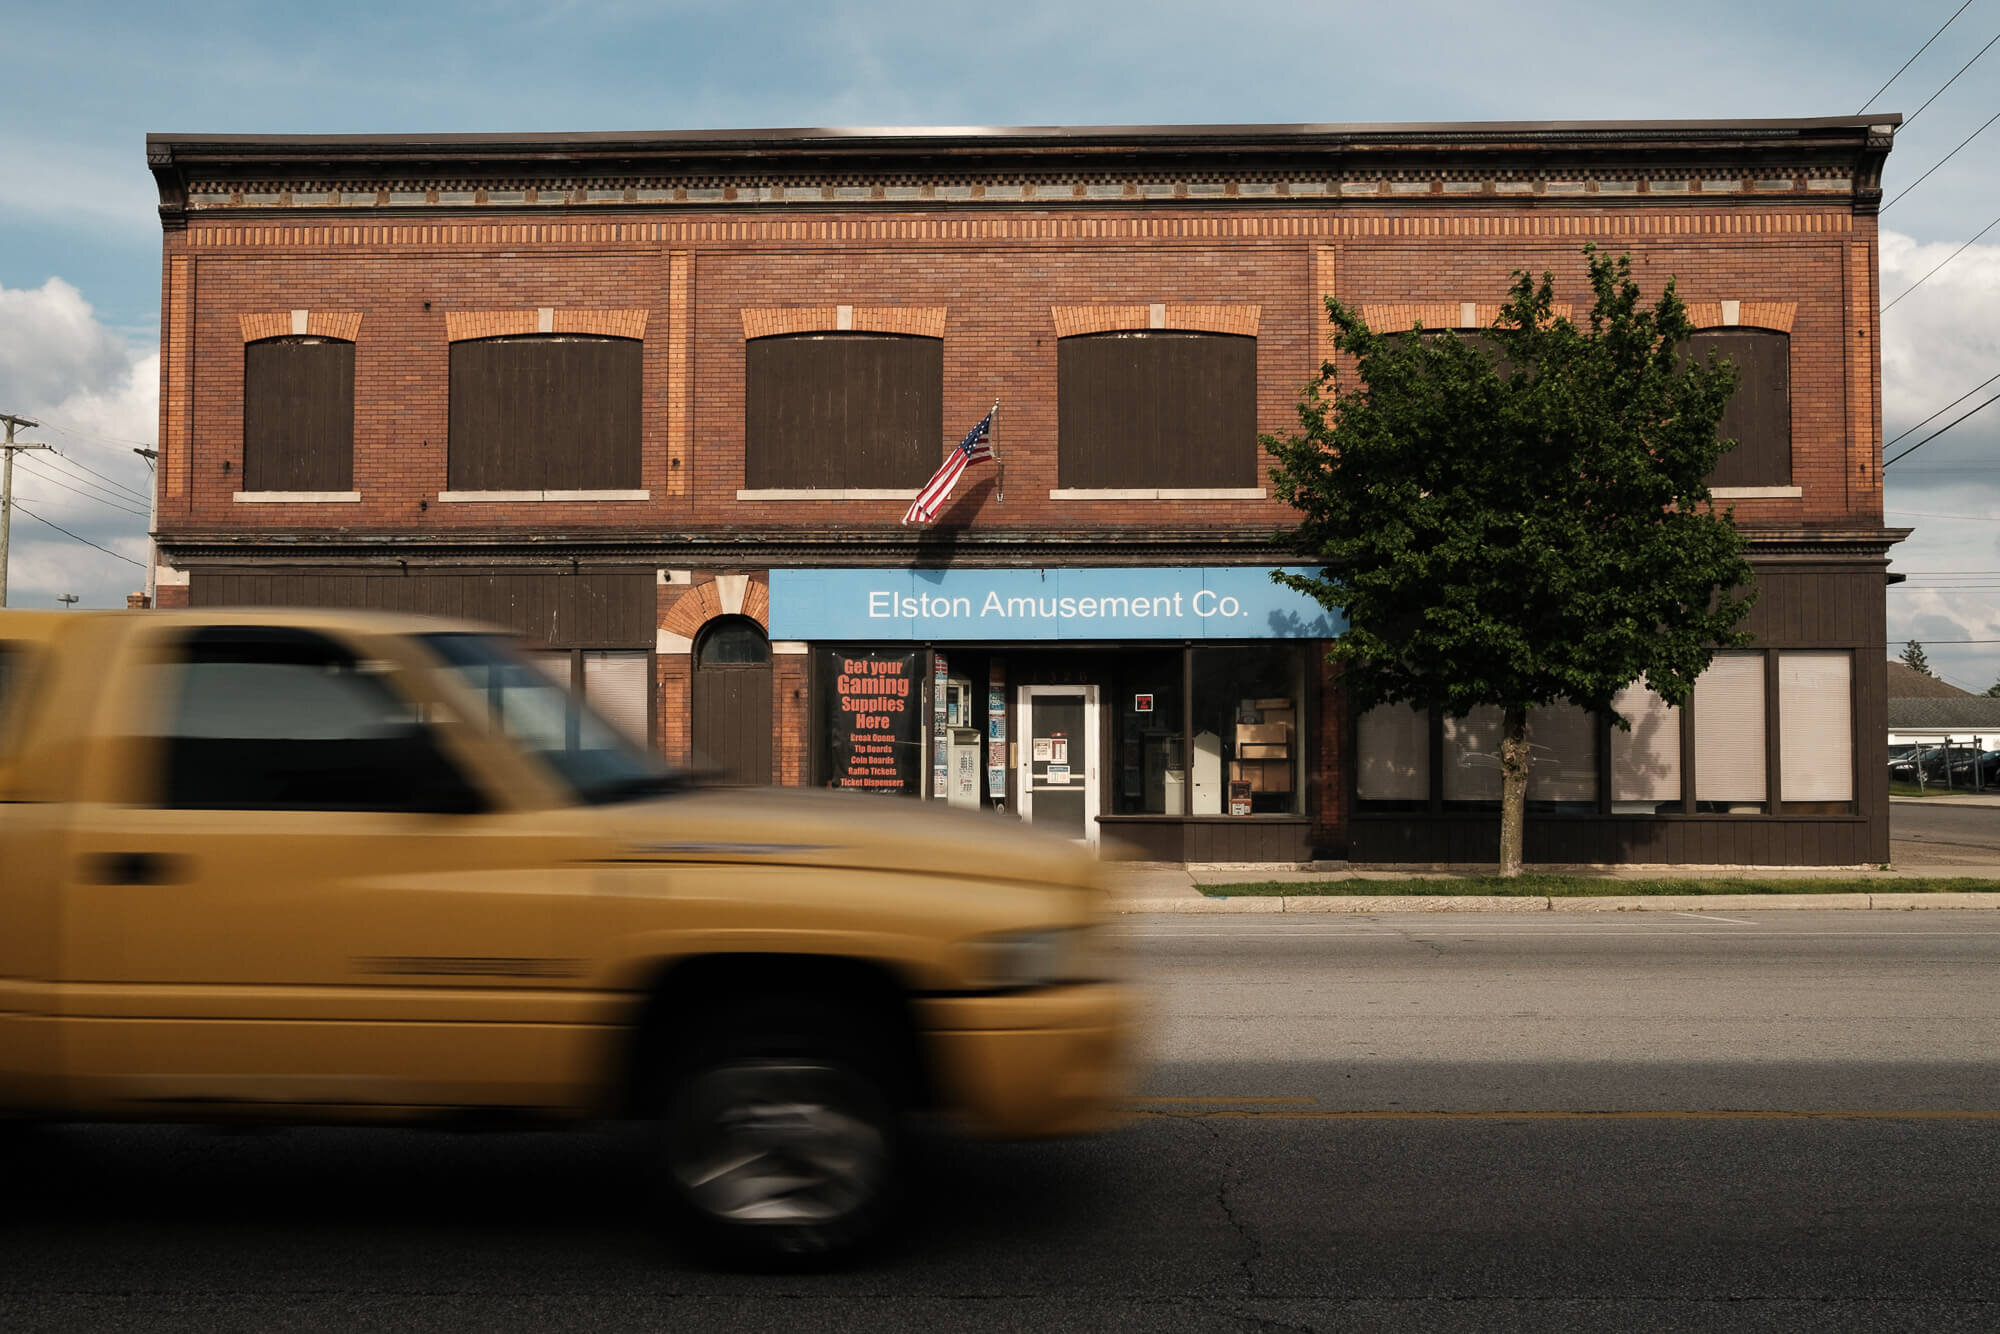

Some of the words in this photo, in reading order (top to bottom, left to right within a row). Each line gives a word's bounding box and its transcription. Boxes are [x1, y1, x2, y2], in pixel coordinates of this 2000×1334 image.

[868, 591, 971, 619] Elston
[980, 591, 1183, 619] Amusement
[1192, 589, 1248, 619] Co.
[843, 659, 869, 674] Get
[870, 660, 904, 676] your
[837, 674, 909, 697] Gaming
[841, 696, 905, 713] Supplies
[855, 713, 891, 729] Here
[855, 744, 866, 754] Tip
[867, 744, 893, 753] Boards
[850, 755, 868, 764] Coin
[868, 755, 894, 764] Boards
[848, 766, 869, 775] Raffle
[870, 766, 897, 775] Tickets
[840, 777, 863, 786] Ticket
[863, 777, 905, 787] Dispensers
